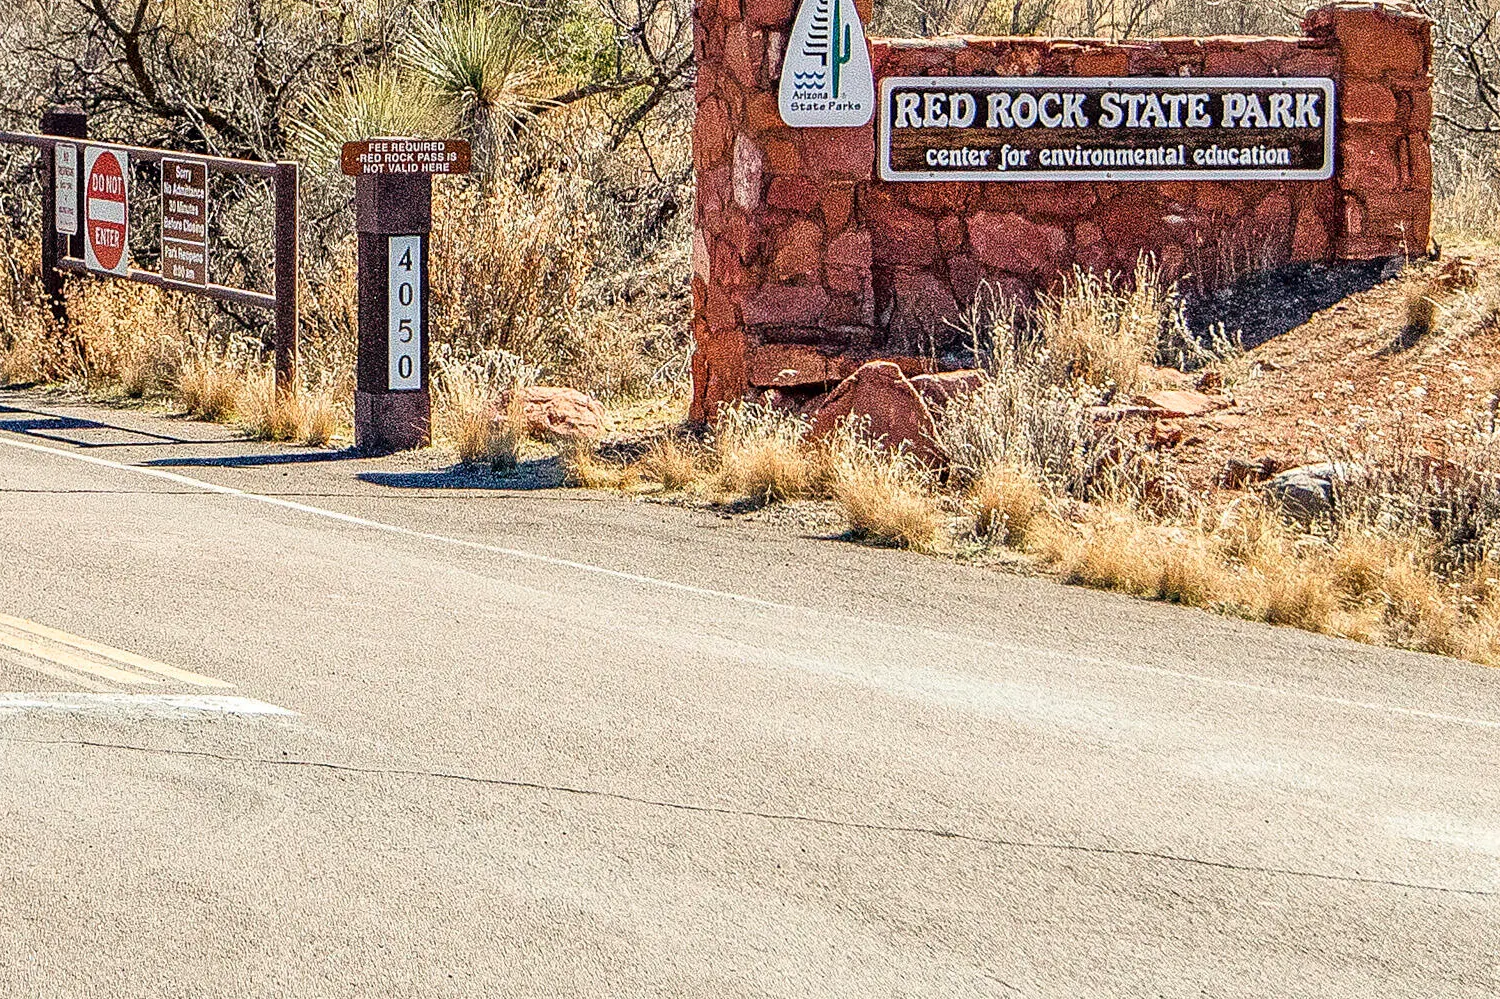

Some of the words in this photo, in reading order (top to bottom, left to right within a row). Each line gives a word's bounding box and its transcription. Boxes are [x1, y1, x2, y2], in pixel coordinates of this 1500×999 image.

[792, 90, 828, 100] Arizona
[790, 101, 826, 111] State
[828, 101, 861, 111] Parks
[894, 92, 977, 128] RED
[986, 92, 1089, 128] ROCK
[1098, 92, 1212, 128] STATE
[1220, 92, 1321, 128] PARK
[368, 142, 389, 152] FEE
[391, 141, 446, 152] REQUIRED
[360, 153, 382, 163] RED
[384, 153, 415, 163] ROCK
[417, 152, 445, 162] PASS
[447, 151, 457, 161] IS
[925, 146, 990, 167] center
[998, 144, 1031, 171] for
[1039, 145, 1186, 167] environmental
[1193, 144, 1290, 166] education
[175, 165, 191, 182] Sorry
[363, 164, 385, 174] NOT
[388, 163, 419, 173] VALID
[421, 163, 450, 173] HERE
[92, 173, 104, 192] DO
[106, 175, 122, 194] NOT
[164, 216, 183, 231] Before
[183, 219, 205, 237] Closing
[95, 226, 120, 248] ENTER
[397, 245, 413, 380] 4050
